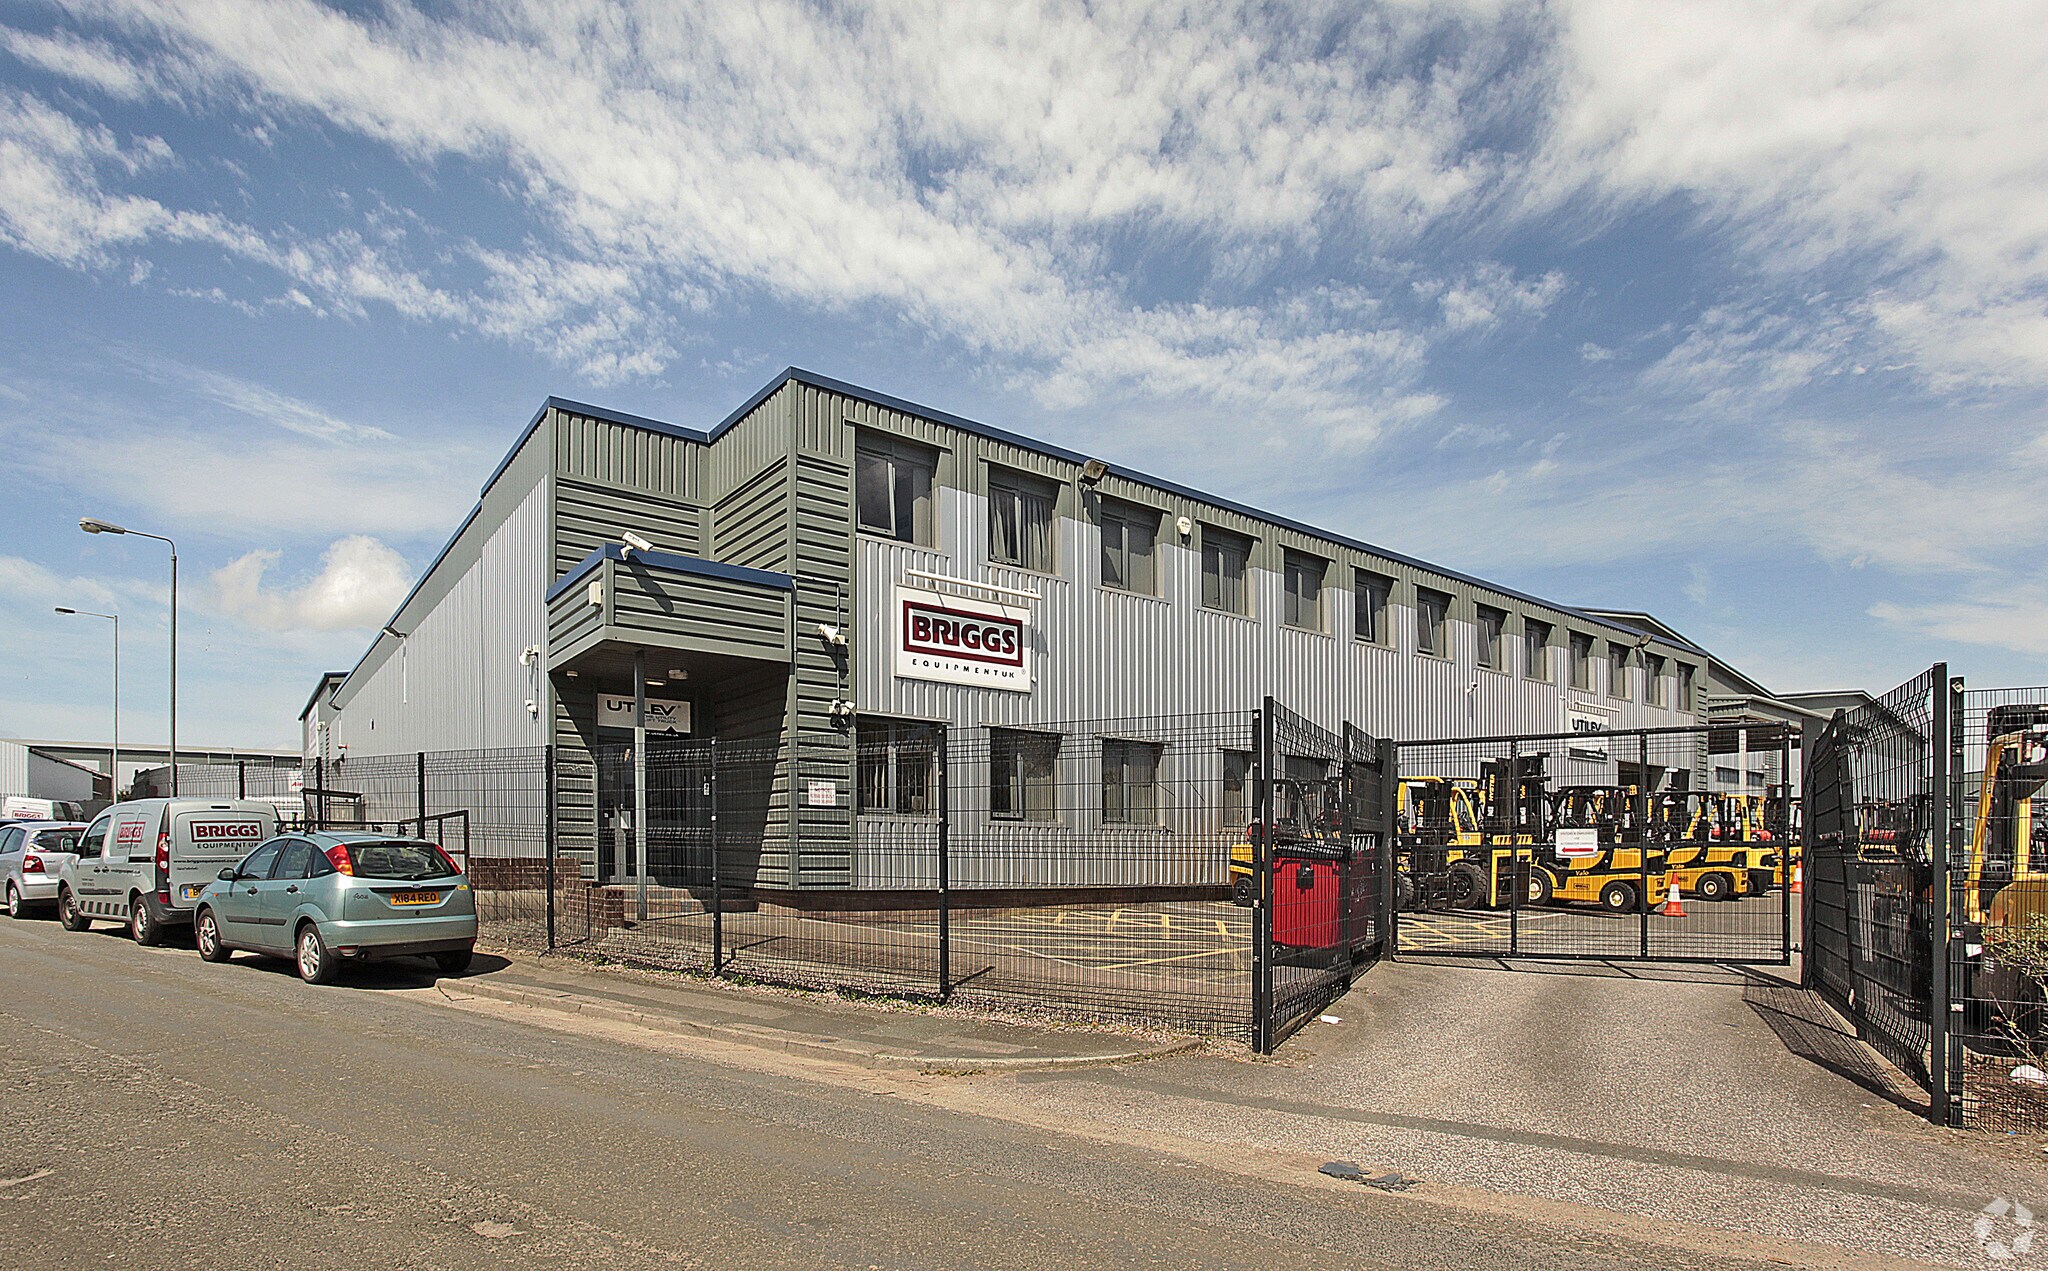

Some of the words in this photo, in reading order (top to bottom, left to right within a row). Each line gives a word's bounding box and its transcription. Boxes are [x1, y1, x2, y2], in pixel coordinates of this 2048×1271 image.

[912, 615, 1015, 654] BRIGGS
[606, 699, 676, 716] UTEV
[1488, 773, 1496, 802] HYSTER
[120, 826, 143, 838] BRIGGS
[196, 825, 259, 838] BRIGGS
